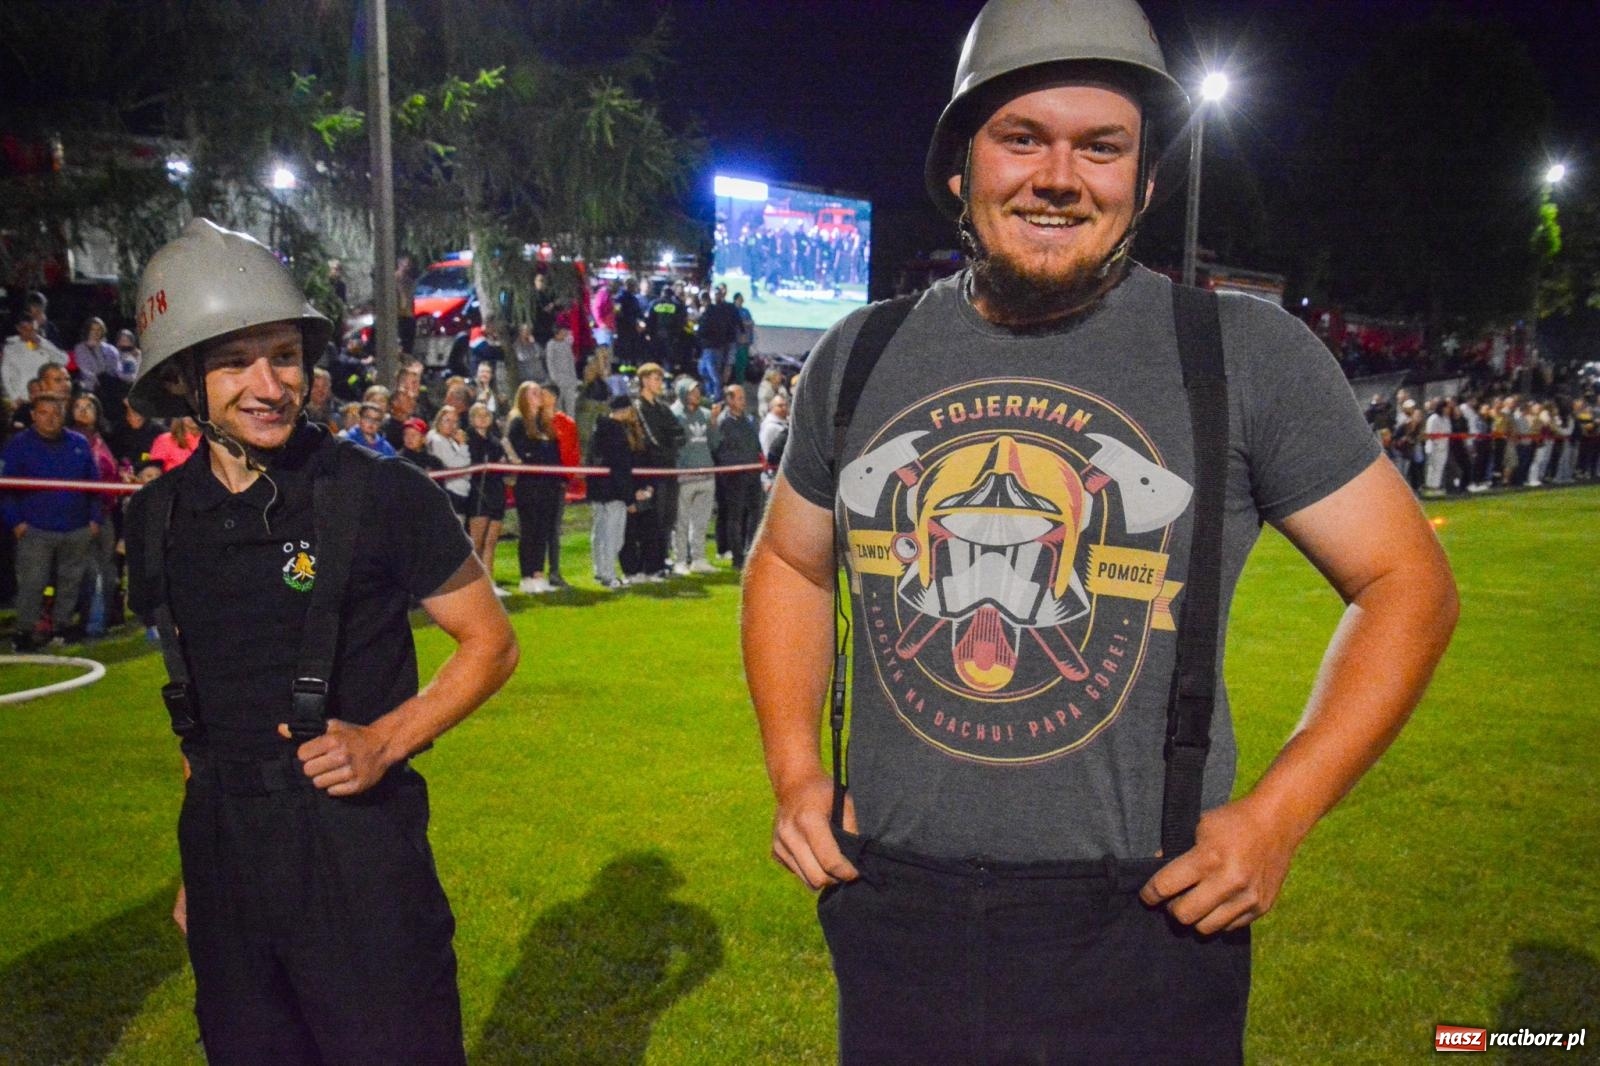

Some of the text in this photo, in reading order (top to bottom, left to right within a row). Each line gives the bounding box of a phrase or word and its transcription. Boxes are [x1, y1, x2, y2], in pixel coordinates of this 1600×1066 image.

[929, 395, 1093, 433] FOJERMAN
[283, 540, 310, 553] OS
[855, 543, 1155, 585] ZAWDY POMOŻE
[905, 688, 925, 713] NA
[933, 710, 1015, 743] DACHU!
[1028, 702, 1083, 738] PAPA
[1085, 633, 1129, 701] GORE!
